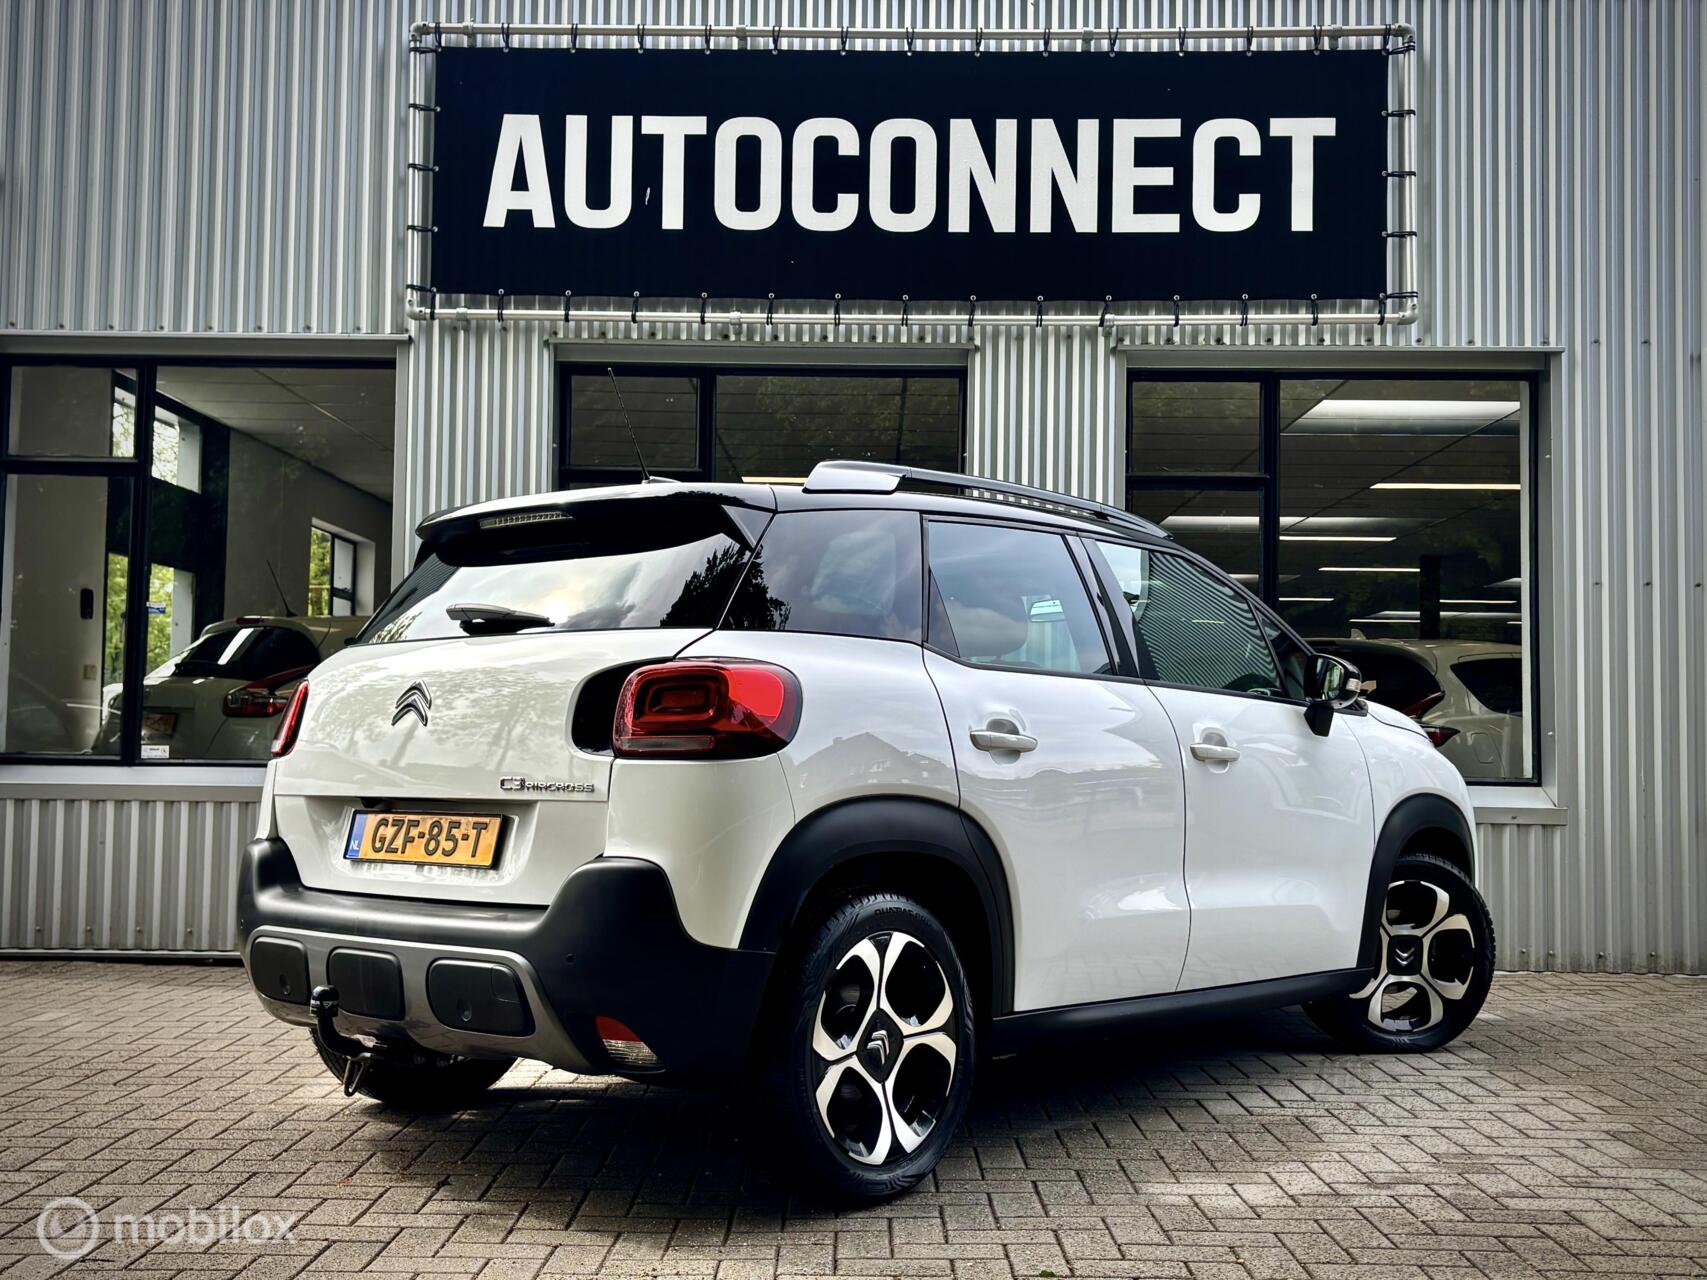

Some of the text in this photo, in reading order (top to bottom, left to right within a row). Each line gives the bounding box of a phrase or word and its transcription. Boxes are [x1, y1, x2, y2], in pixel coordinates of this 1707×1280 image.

[482, 113, 1337, 233] AUTOCONNECT
[500, 776, 594, 793] C3 AIRCROSS
[350, 840, 360, 850] NL
[371, 818, 488, 858] GZF-85-T
